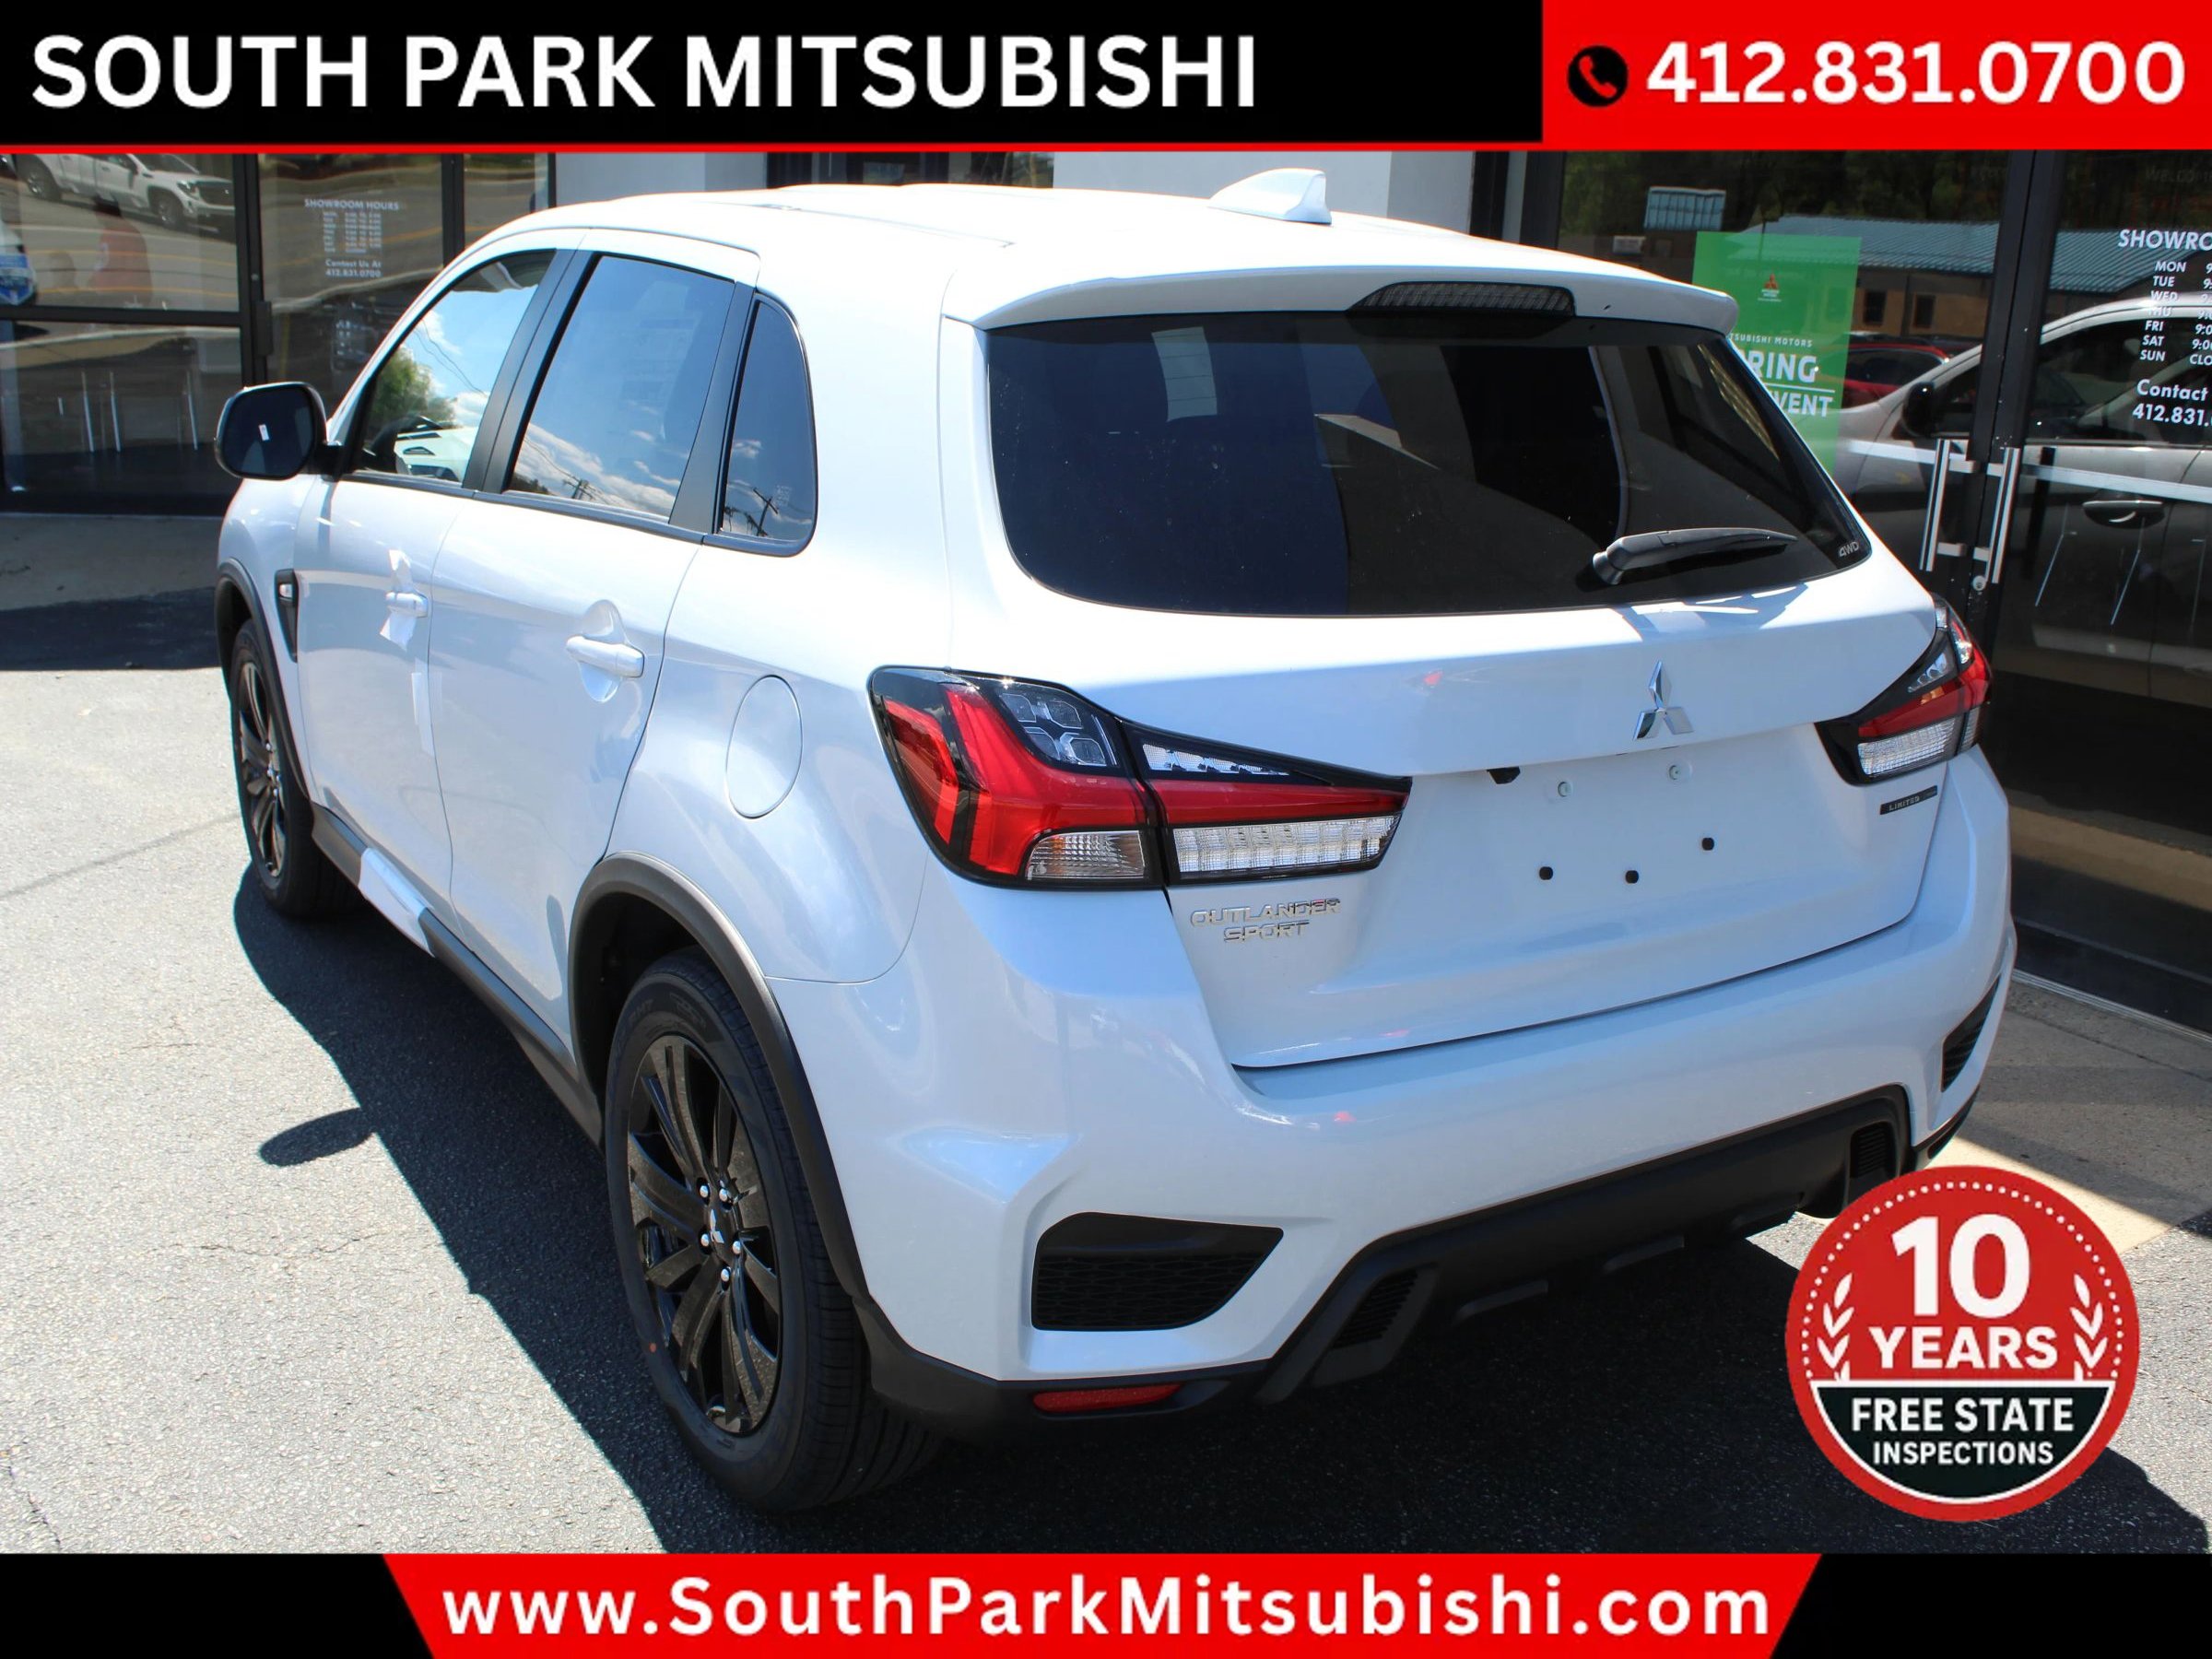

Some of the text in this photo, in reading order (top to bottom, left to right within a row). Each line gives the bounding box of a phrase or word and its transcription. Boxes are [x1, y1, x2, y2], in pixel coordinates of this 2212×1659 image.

[304, 198, 399, 210] SHOWROOM HOURS
[2154, 261, 2187, 273] MON
[2153, 276, 2175, 288] TUE
[2150, 290, 2178, 302] WED
[2145, 320, 2164, 332] FRI
[1774, 336, 1813, 347] MOTORS
[2142, 335, 2165, 347] SAT
[2139, 349, 2166, 362] SUN
[1741, 349, 1818, 383] RING
[2136, 378, 2208, 403] Contact
[1770, 390, 1833, 418] VENT
[2132, 404, 2212, 428] 412.831.
[1839, 541, 1859, 558] 4WD
[1888, 795, 1921, 811] LIMITED
[1191, 898, 1340, 926] OUTLANDER
[1223, 919, 1311, 944] SPORT
